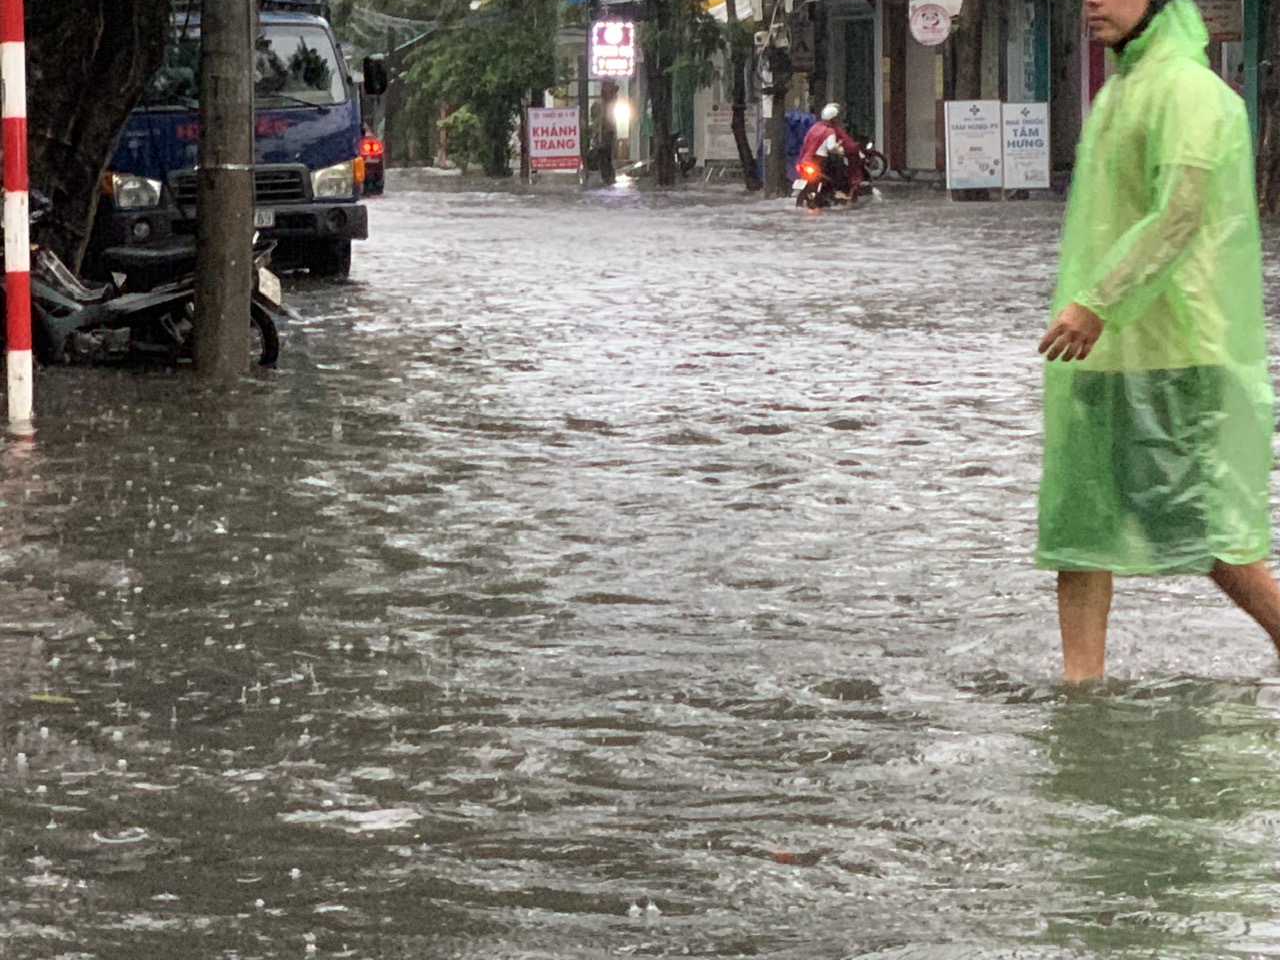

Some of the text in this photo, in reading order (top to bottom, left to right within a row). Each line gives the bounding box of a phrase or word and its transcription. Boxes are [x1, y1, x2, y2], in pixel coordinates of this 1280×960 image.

[532, 123, 577, 138] KHÁNH
[1012, 126, 1039, 137] TÂM
[534, 139, 576, 150] TRANG
[1007, 138, 1044, 149] HƯNG
